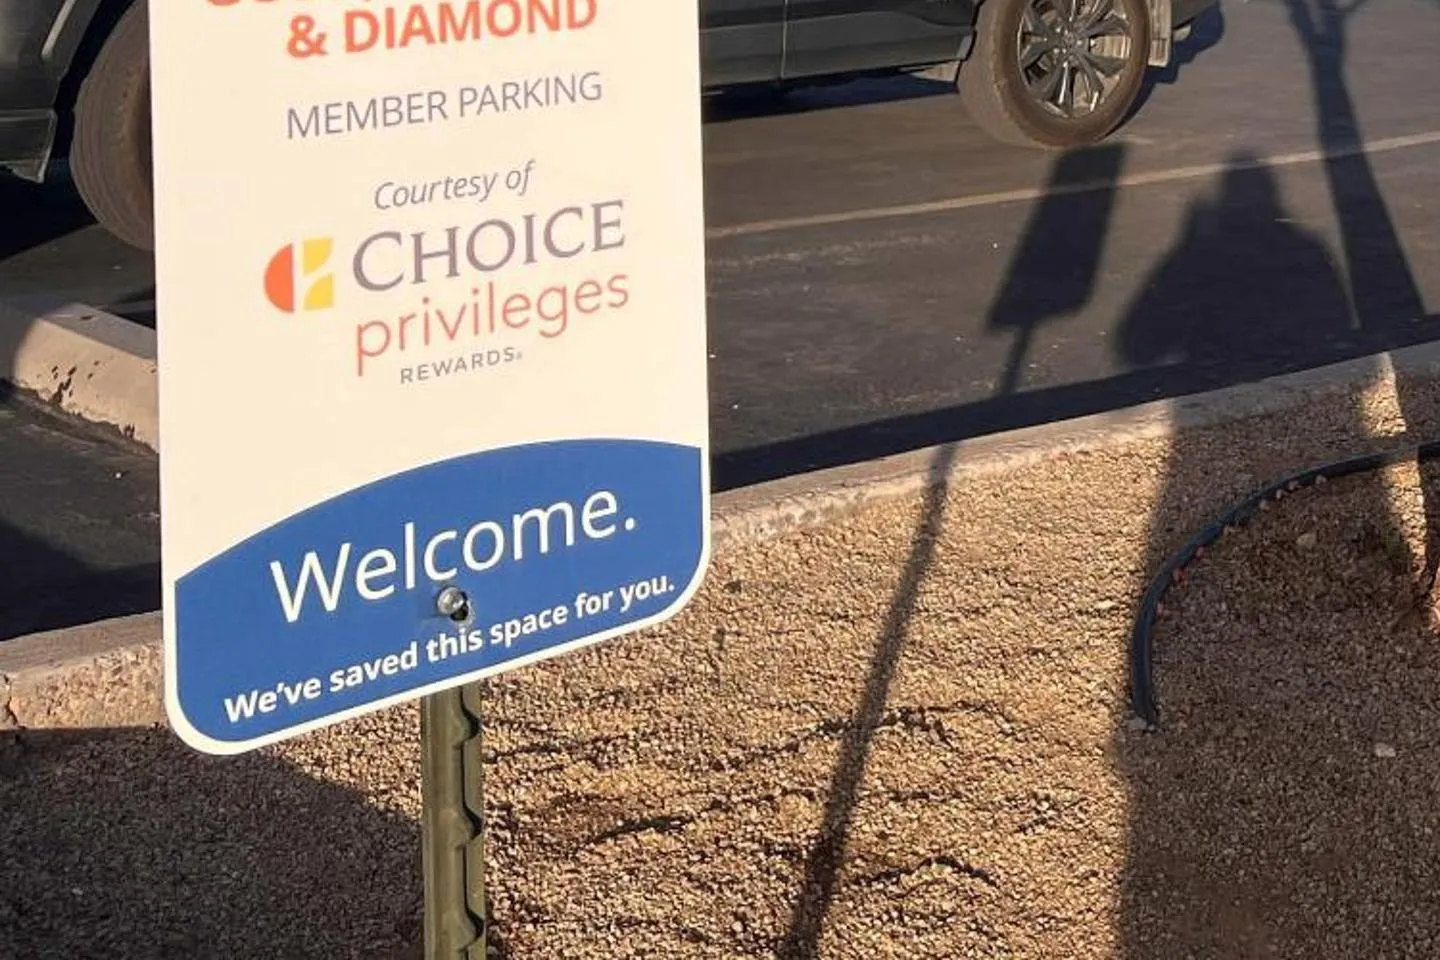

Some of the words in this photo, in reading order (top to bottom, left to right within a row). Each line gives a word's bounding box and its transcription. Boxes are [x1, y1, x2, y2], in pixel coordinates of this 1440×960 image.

[286, 15, 329, 58] &
[287, 89, 449, 139] MEMBER
[459, 71, 602, 117] PARKING
[374, 170, 498, 210] Courtesy
[505, 159, 536, 196] of
[352, 199, 626, 292] CHOICE
[357, 273, 629, 376] privileges
[269, 489, 636, 623] Welcome.
[223, 676, 322, 724] We've
[329, 643, 418, 692] saved
[426, 624, 483, 664] this
[490, 605, 567, 648] space
[575, 588, 613, 621] for
[619, 573, 676, 613] you.
